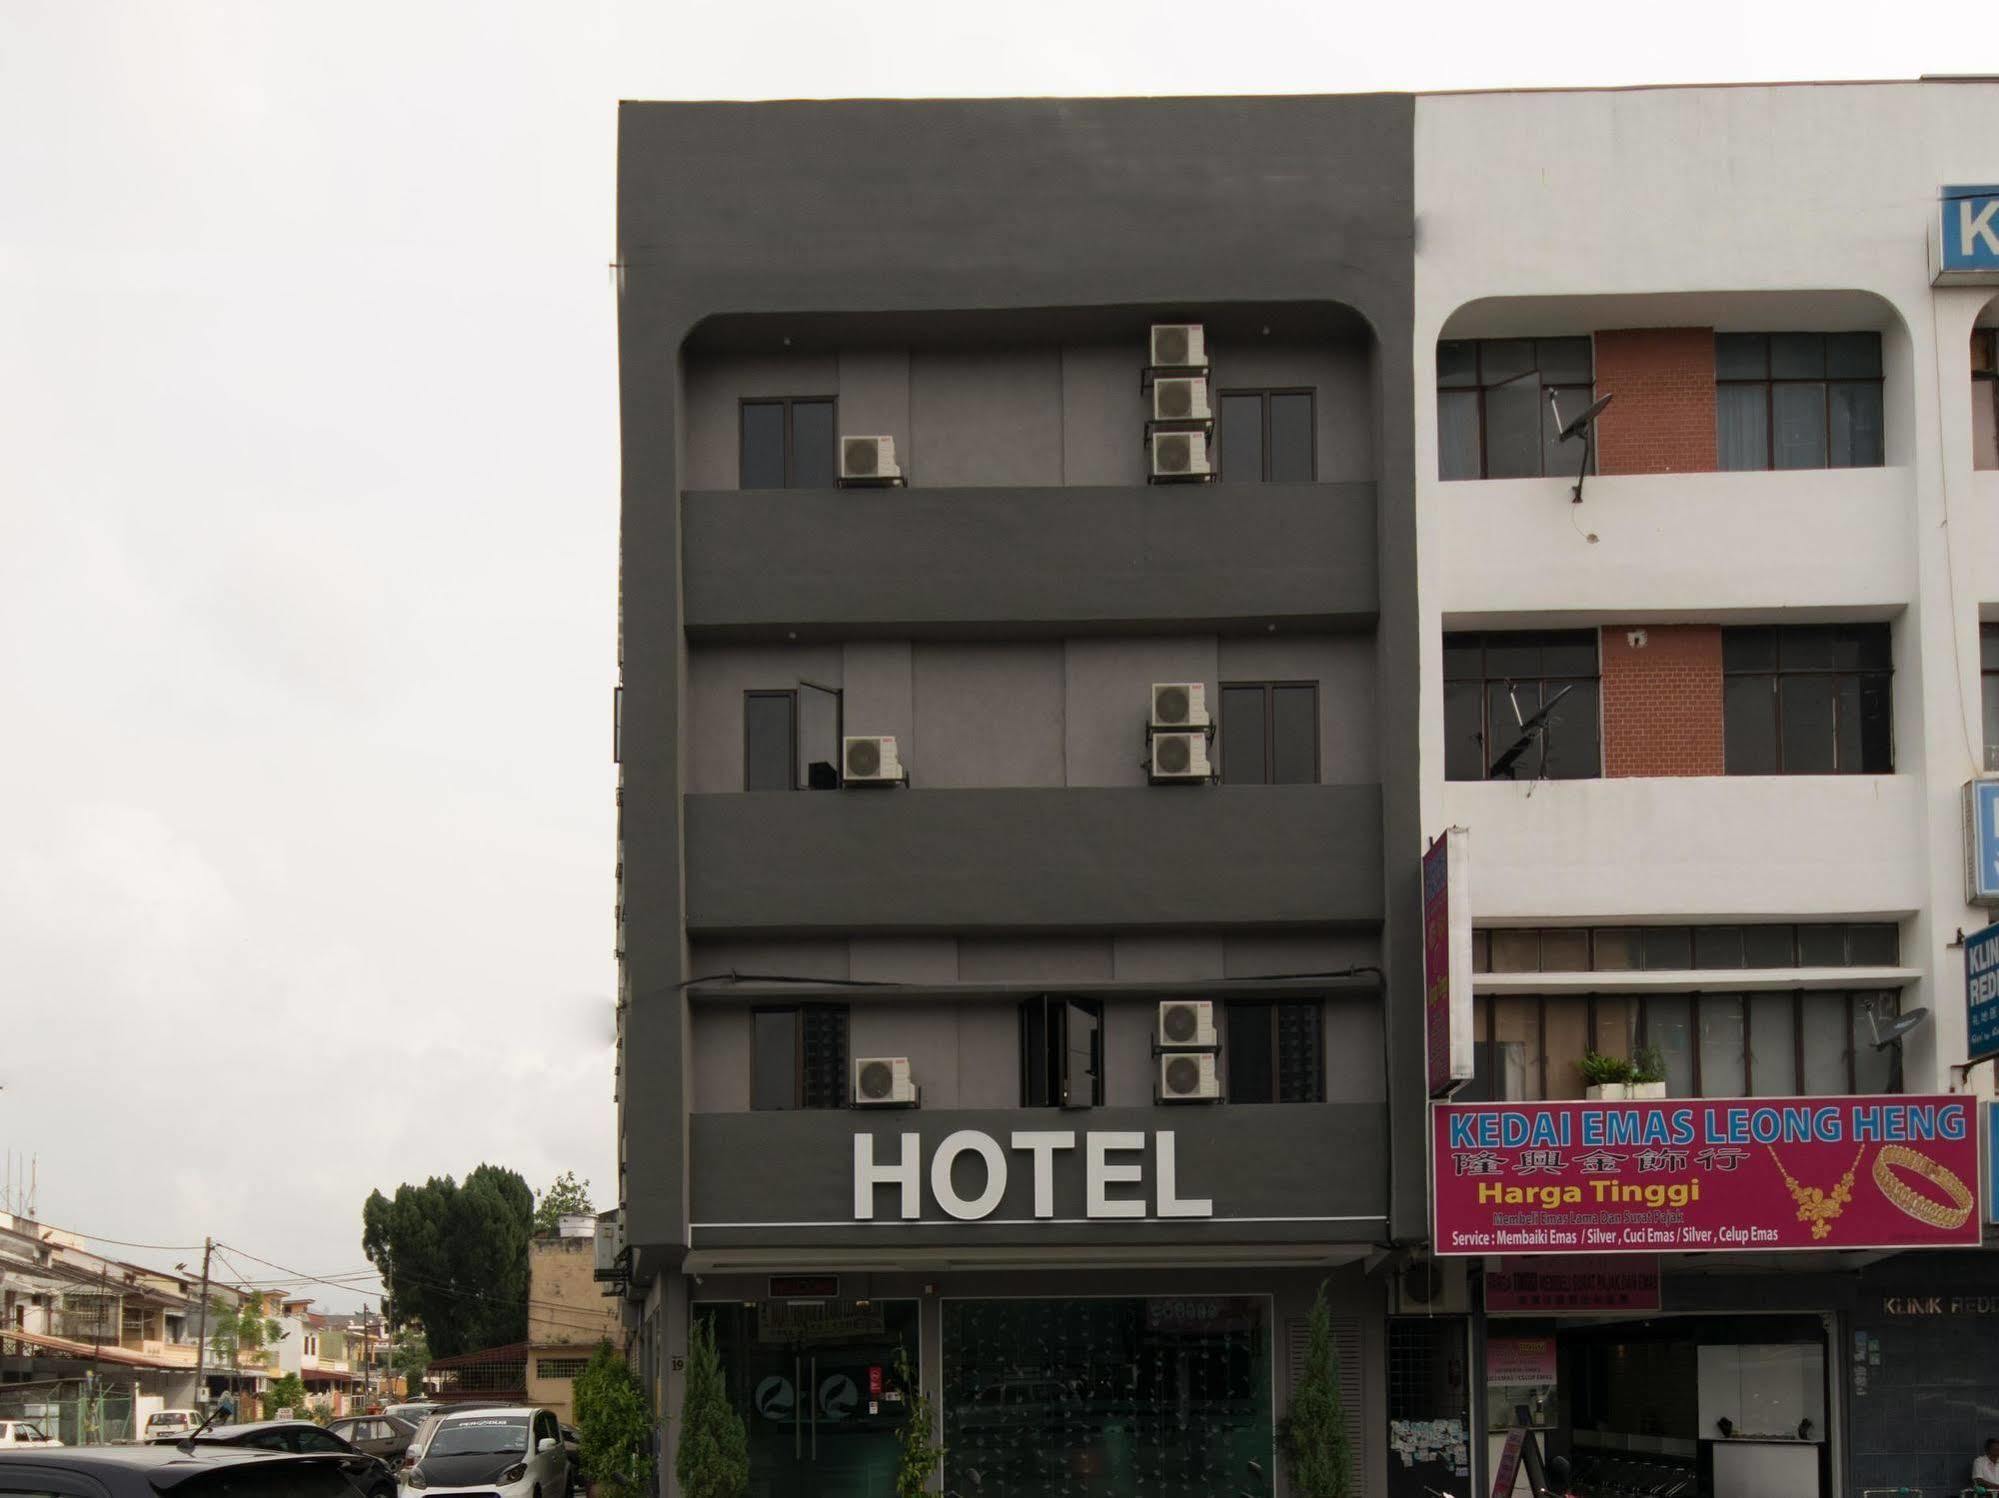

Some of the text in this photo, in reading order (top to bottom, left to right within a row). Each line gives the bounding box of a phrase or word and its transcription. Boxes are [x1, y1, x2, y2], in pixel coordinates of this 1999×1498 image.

[1970, 968, 1999, 1007] RED
[1449, 1104, 1966, 1148] KEDAI EMAS LEONG HENG
[854, 1129, 1213, 1220] HOTEL
[1451, 1148, 1750, 1176] 隆興金飾行
[1478, 1178, 1700, 1209] Harga Tinggi
[1493, 1211, 1538, 1226] Membeli
[1541, 1211, 1569, 1225] Emas
[1570, 1211, 1598, 1225] Lama
[1623, 1209, 1653, 1224] Surat
[1497, 1229, 1548, 1245] Membaiki
[1550, 1230, 1577, 1245] Emas
[1623, 1228, 1645, 1243] Cuci
[1647, 1228, 1674, 1243] Emas
[1719, 1226, 1749, 1245] Celup
[1751, 1226, 1778, 1241] Emas
